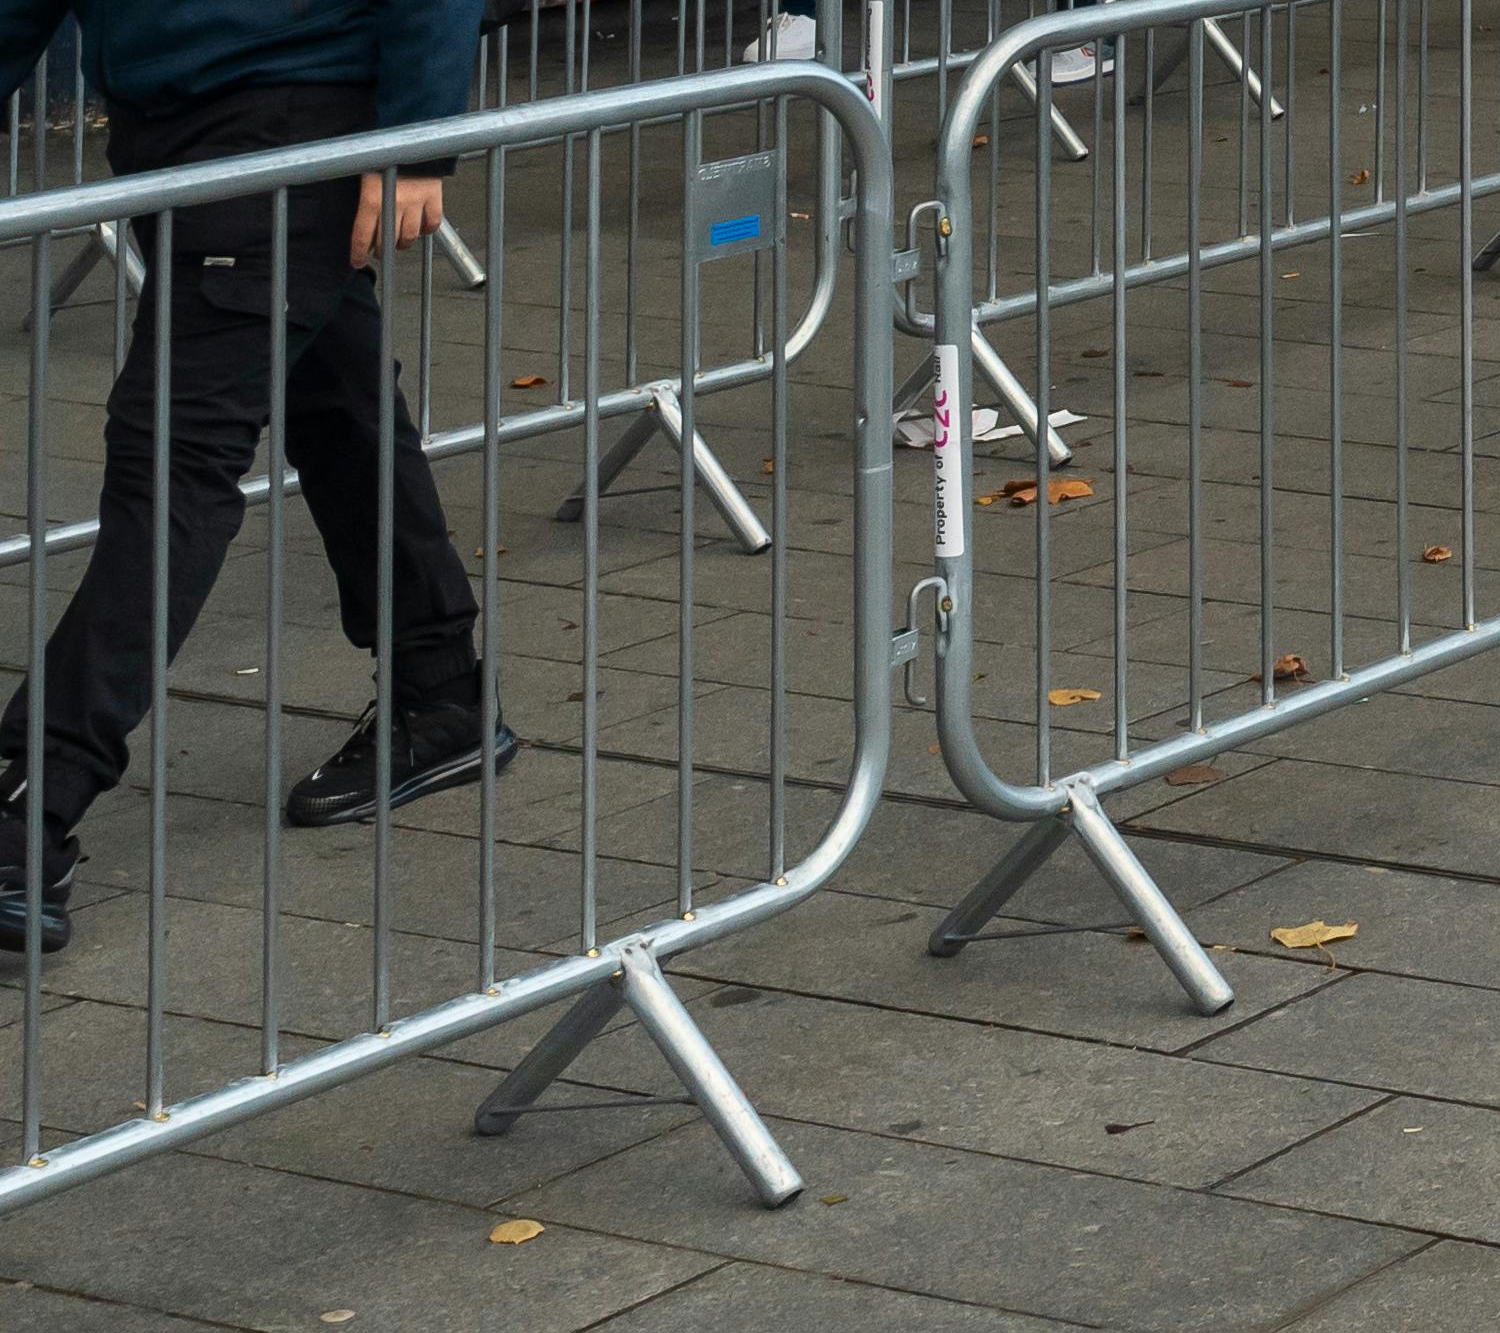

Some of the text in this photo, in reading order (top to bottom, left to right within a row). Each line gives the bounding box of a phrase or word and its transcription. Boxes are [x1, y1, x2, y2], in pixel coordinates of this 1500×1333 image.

[934, 389, 950, 448] c2c
[936, 455, 944, 470] of
[936, 476, 948, 545] Property
